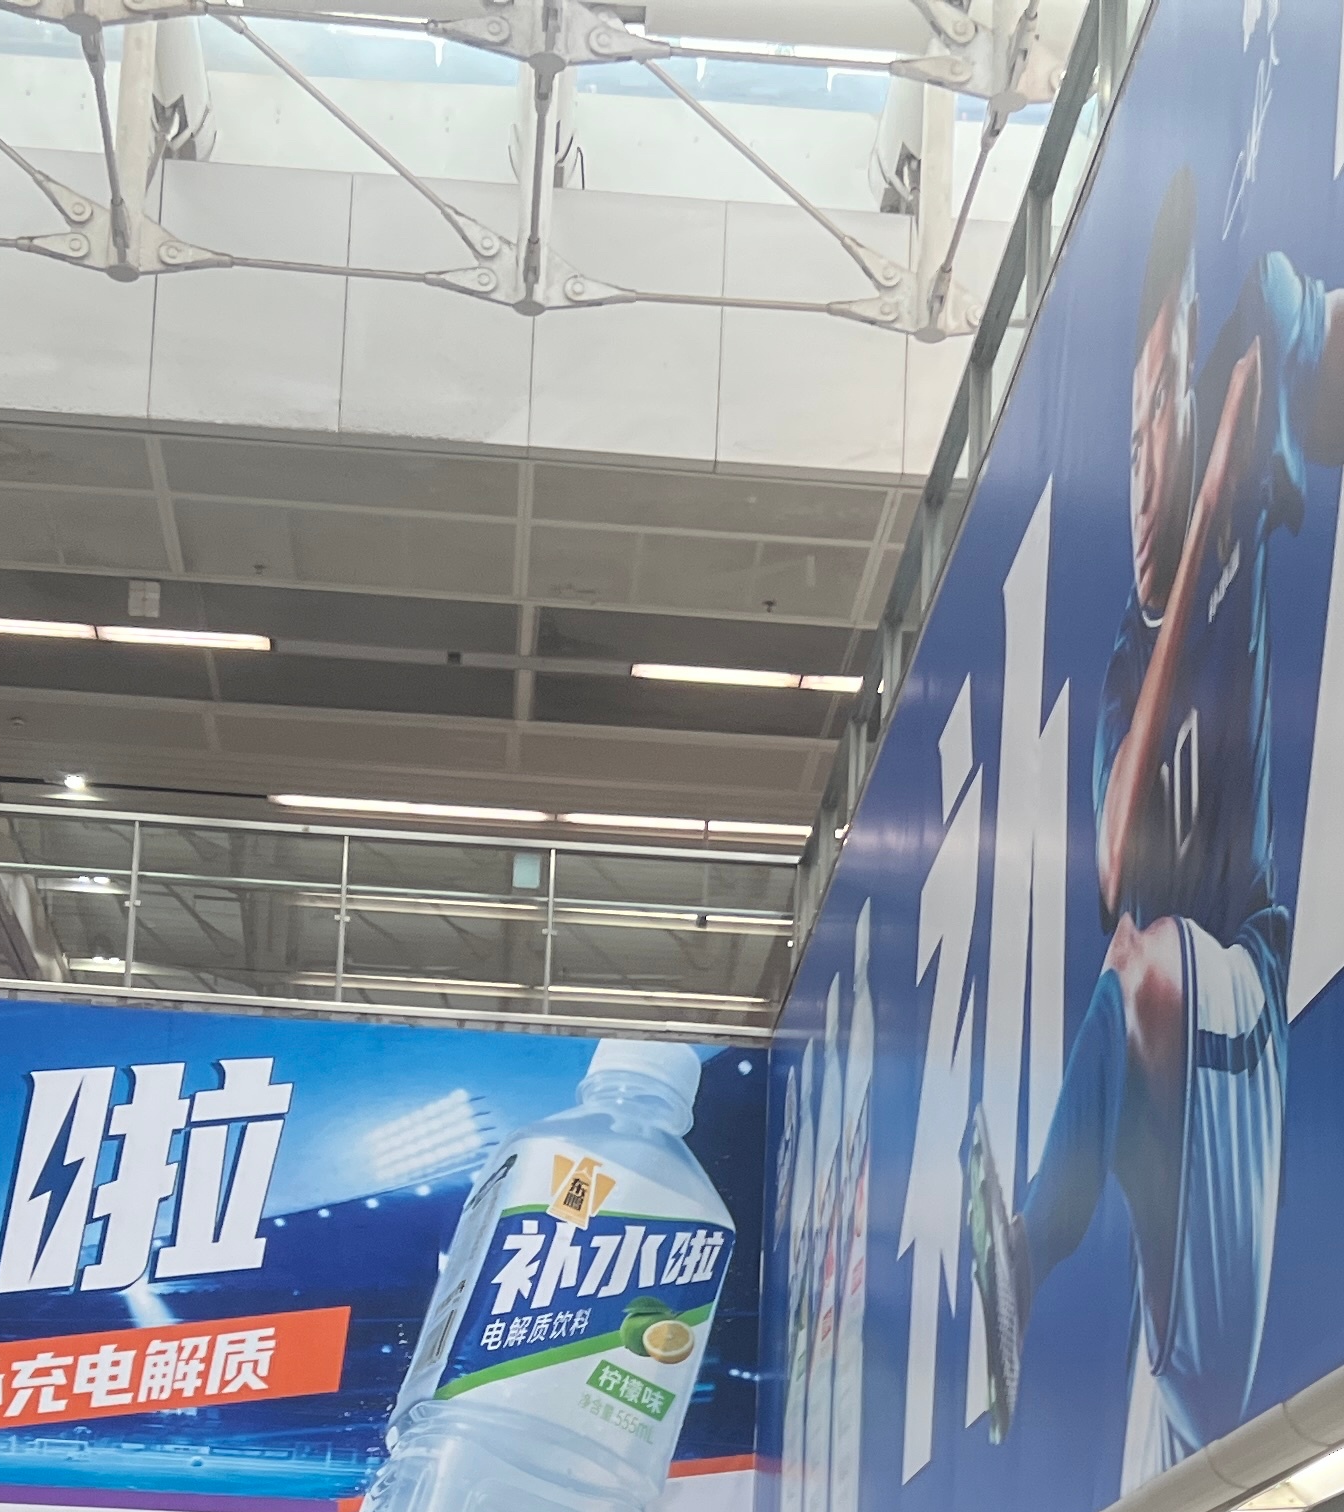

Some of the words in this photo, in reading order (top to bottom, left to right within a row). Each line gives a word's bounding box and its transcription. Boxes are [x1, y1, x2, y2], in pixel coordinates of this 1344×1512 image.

[491, 1220, 726, 1314] 补水啦
[480, 1307, 592, 1351] 电解质饮料
[598, 1365, 665, 1415] 柠檬味
